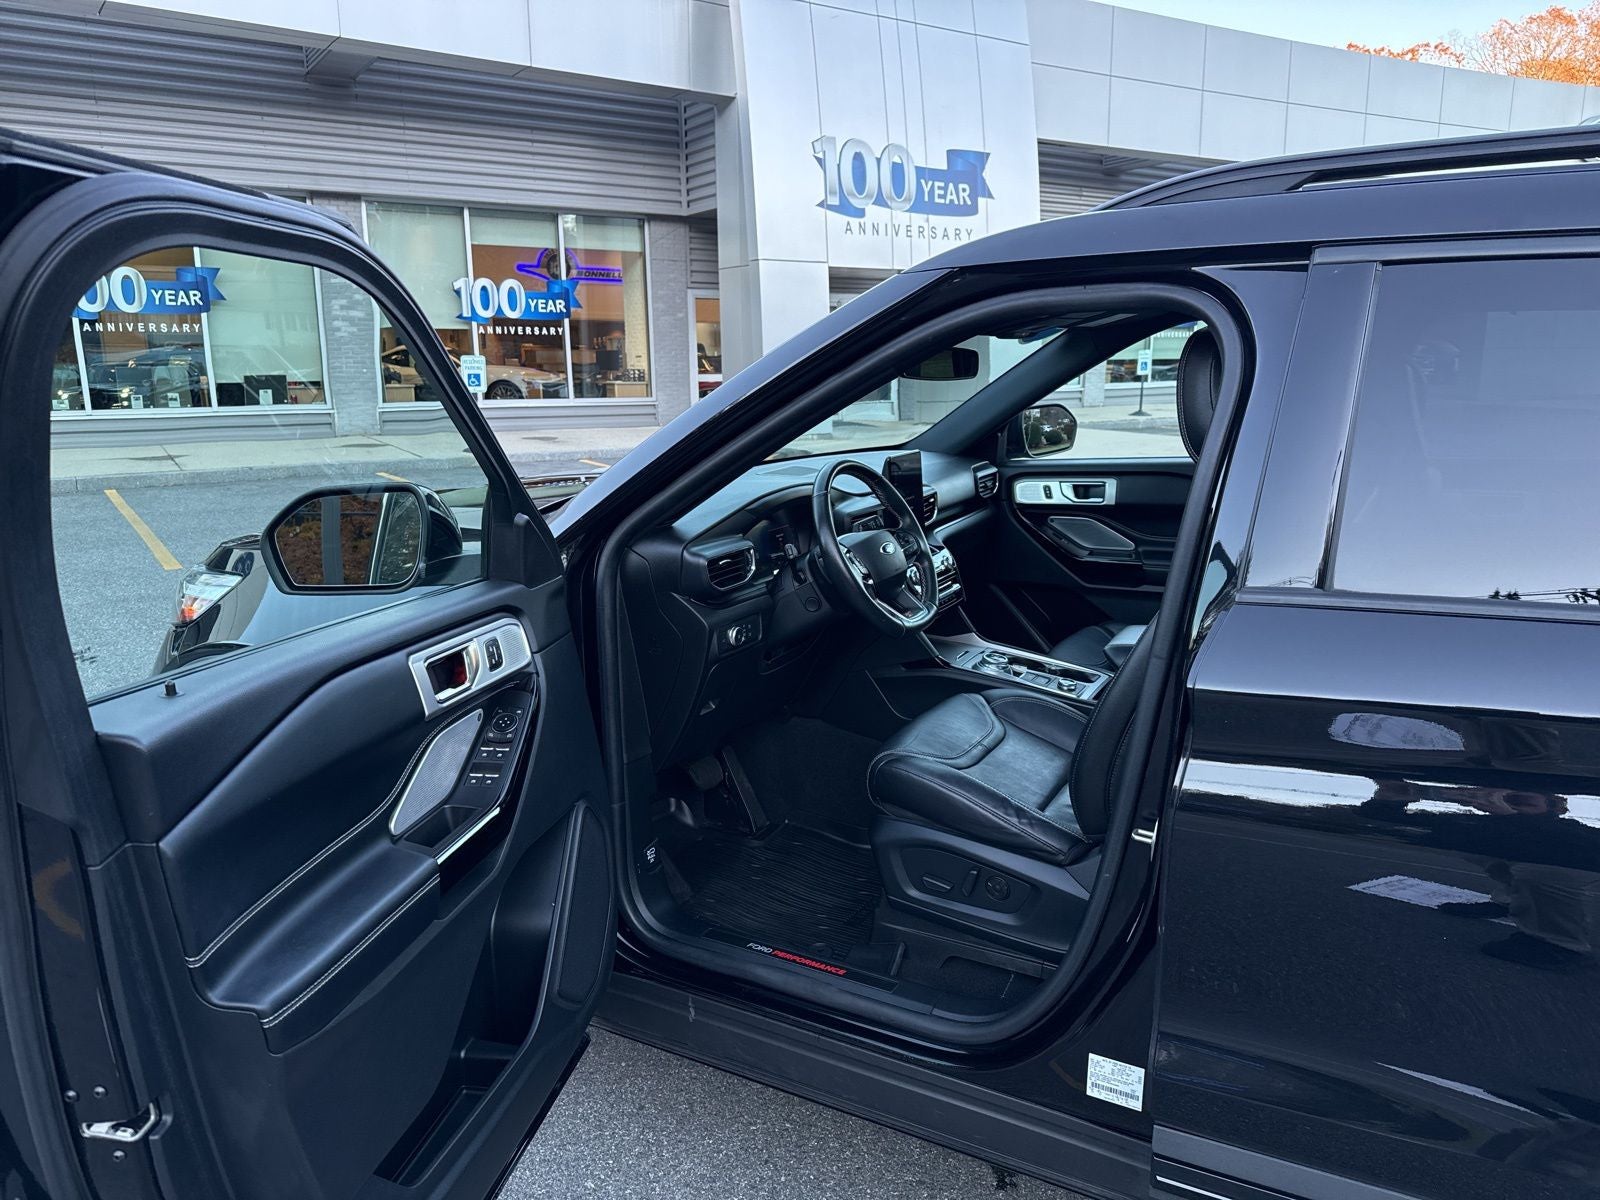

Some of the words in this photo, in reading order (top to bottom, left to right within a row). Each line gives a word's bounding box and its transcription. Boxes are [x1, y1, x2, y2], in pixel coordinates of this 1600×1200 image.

[812, 135, 916, 212] 100
[920, 179, 972, 206] YEAR
[845, 220, 973, 241] ANNIVERSARY
[77, 266, 148, 314] 00
[151, 289, 203, 306] YEAR
[453, 277, 526, 319] 100
[528, 298, 567, 313] YEAR
[82, 322, 201, 333] ANNIVERSARY
[478, 325, 564, 336] ANNIVERSARY
[747, 942, 773, 953] FORD
[772, 950, 847, 975] PERFORMANCE
